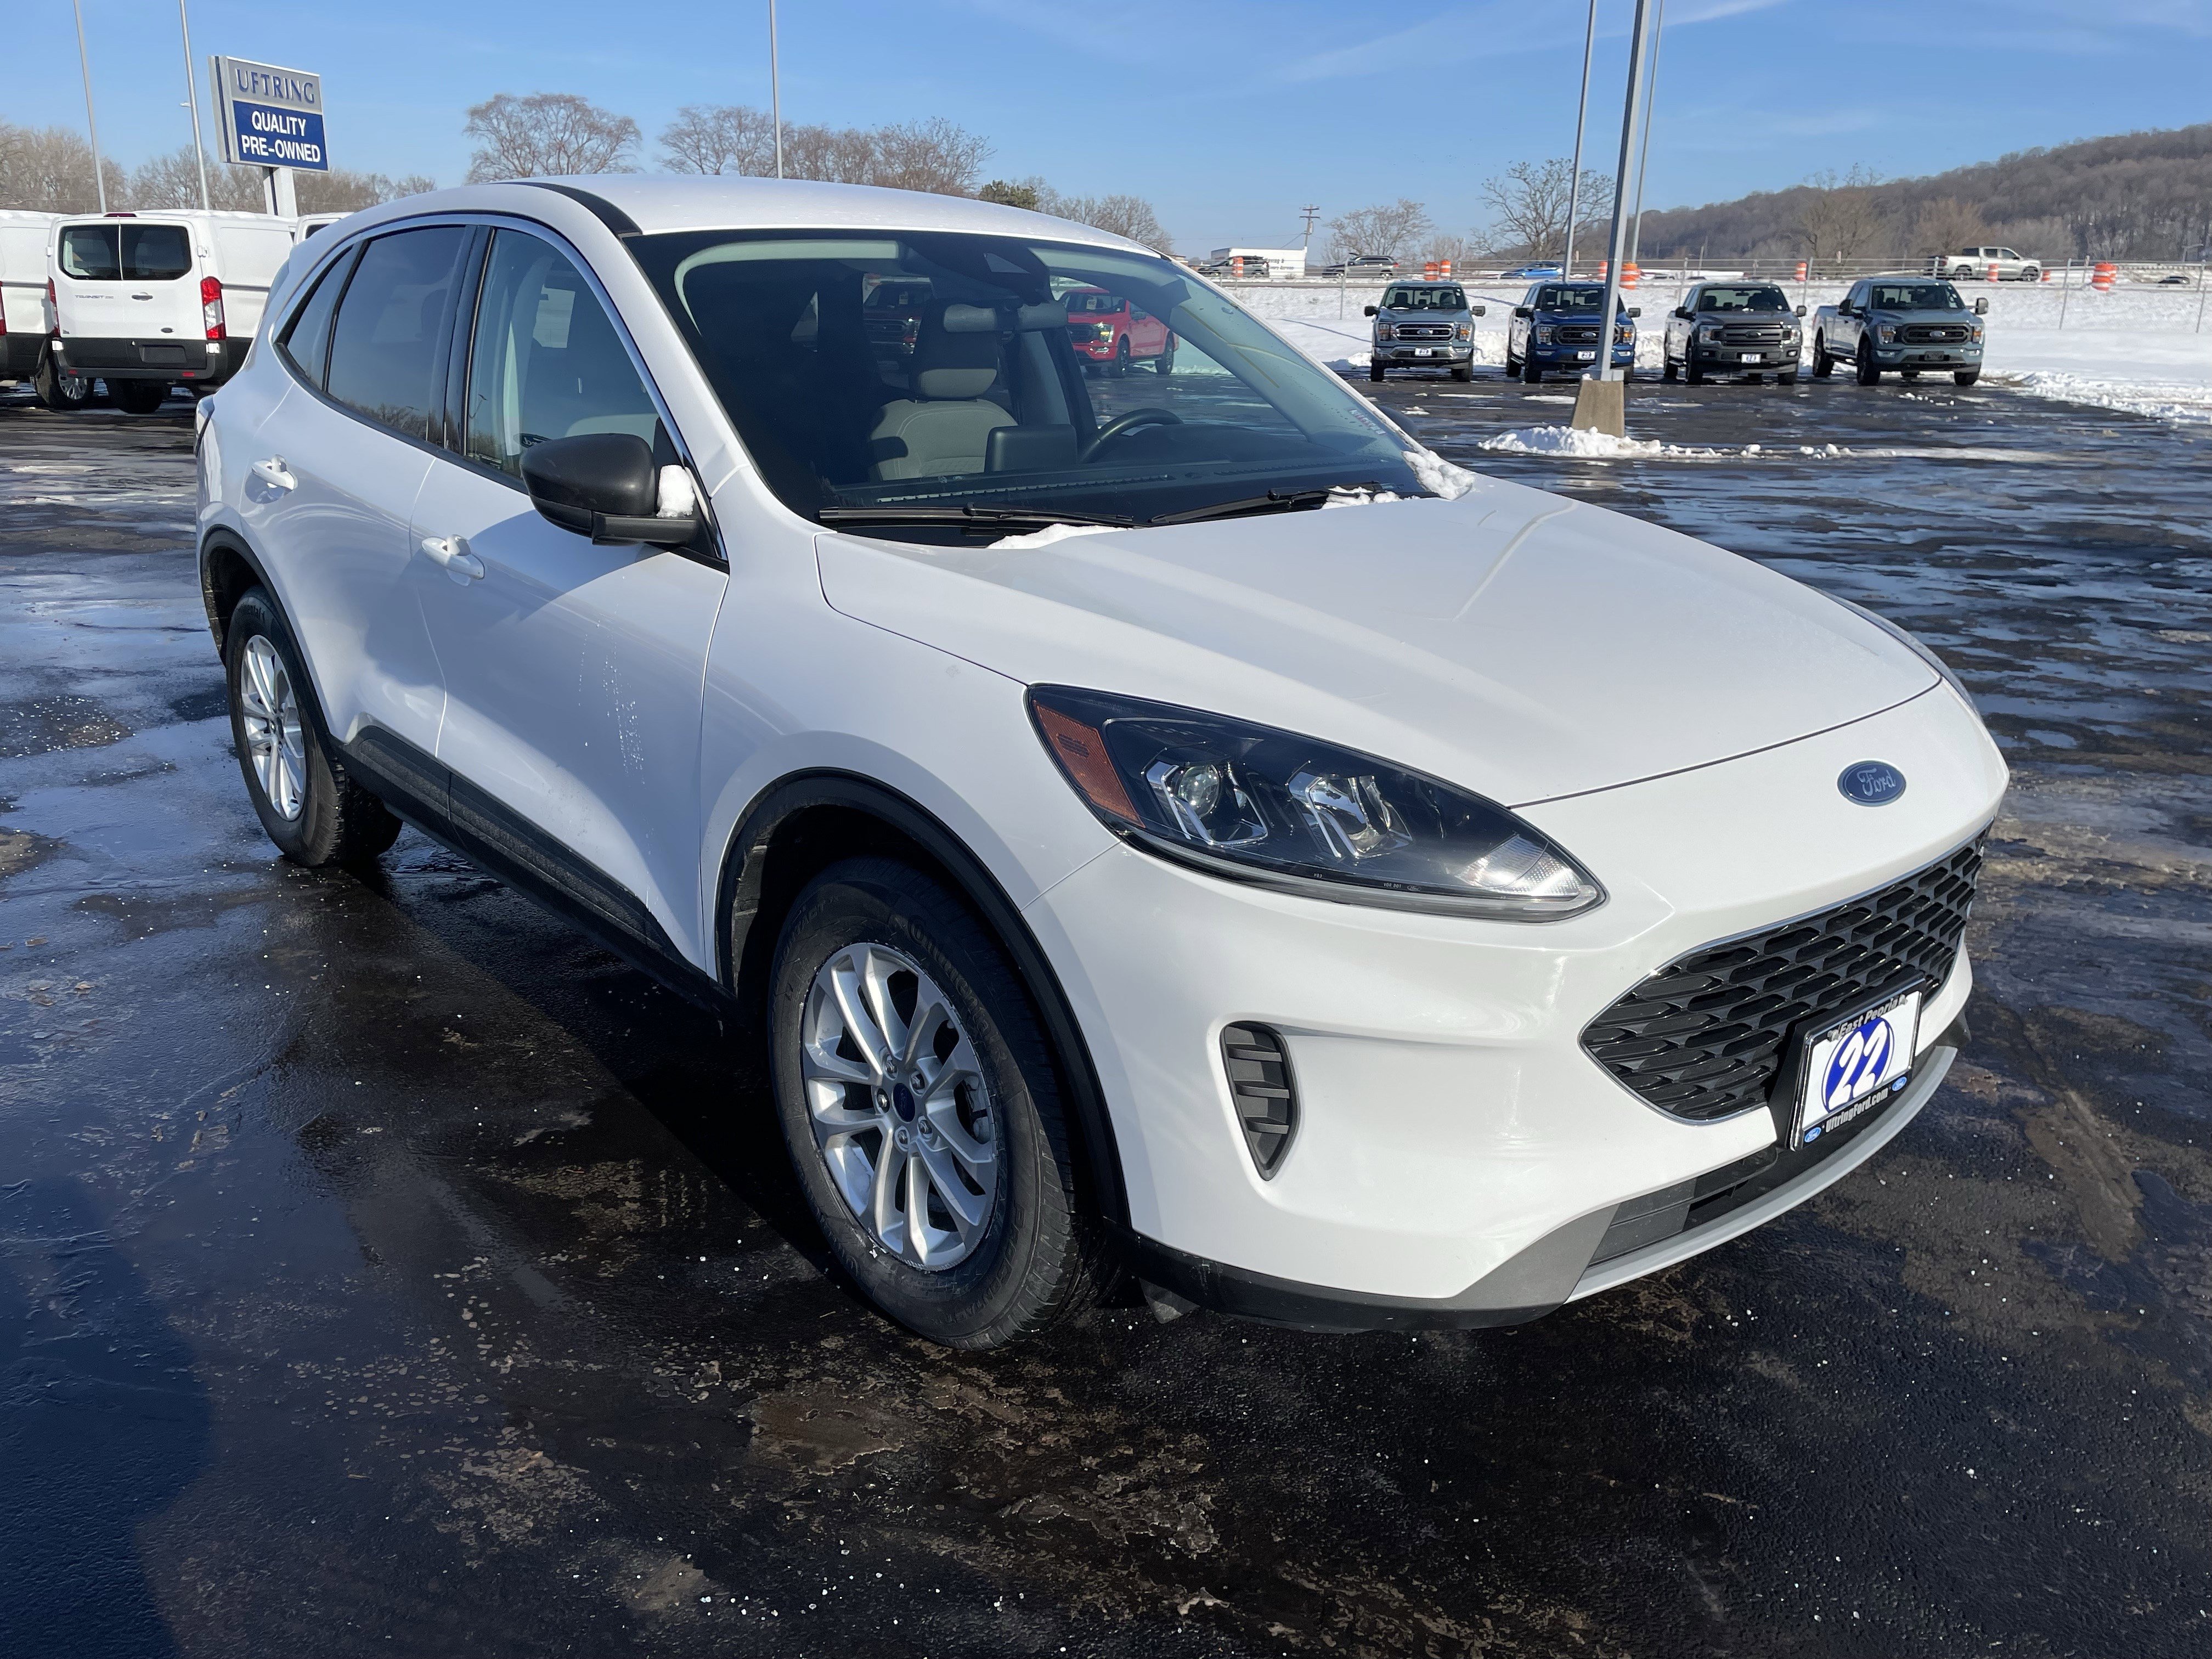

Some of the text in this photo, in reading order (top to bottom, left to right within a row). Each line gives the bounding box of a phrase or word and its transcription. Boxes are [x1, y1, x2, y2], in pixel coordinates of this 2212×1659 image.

[235, 68, 314, 104] UFTRING
[251, 111, 306, 137] QUALITY
[241, 134, 320, 162] PRE-OWNED
[1857, 768, 1896, 796] Ford
[1838, 997, 1899, 1037] East Peoria
[1828, 1021, 1887, 1110] 22
